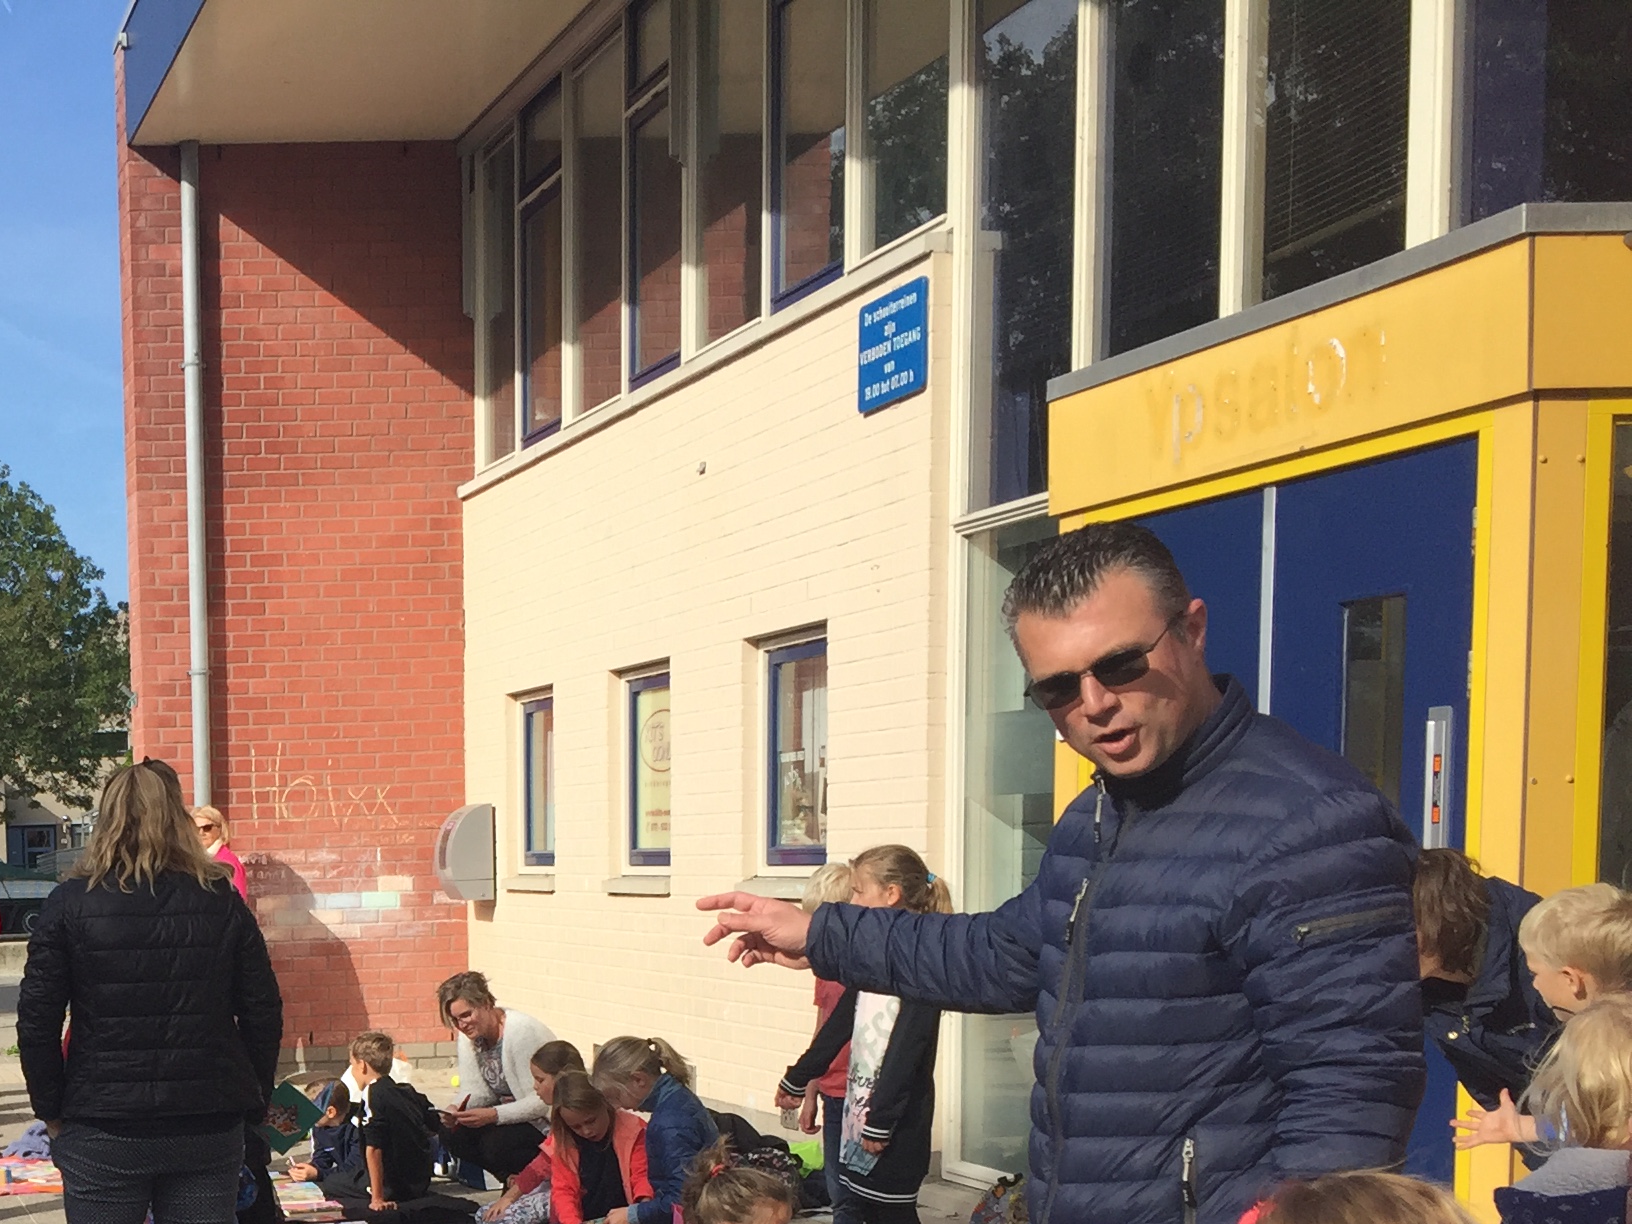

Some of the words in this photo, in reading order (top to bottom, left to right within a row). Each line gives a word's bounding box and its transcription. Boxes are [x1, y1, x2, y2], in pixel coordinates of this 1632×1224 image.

[860, 340, 892, 366] VERBODEN
[892, 326, 921, 351] TOEGANG
[883, 360, 895, 374] van
